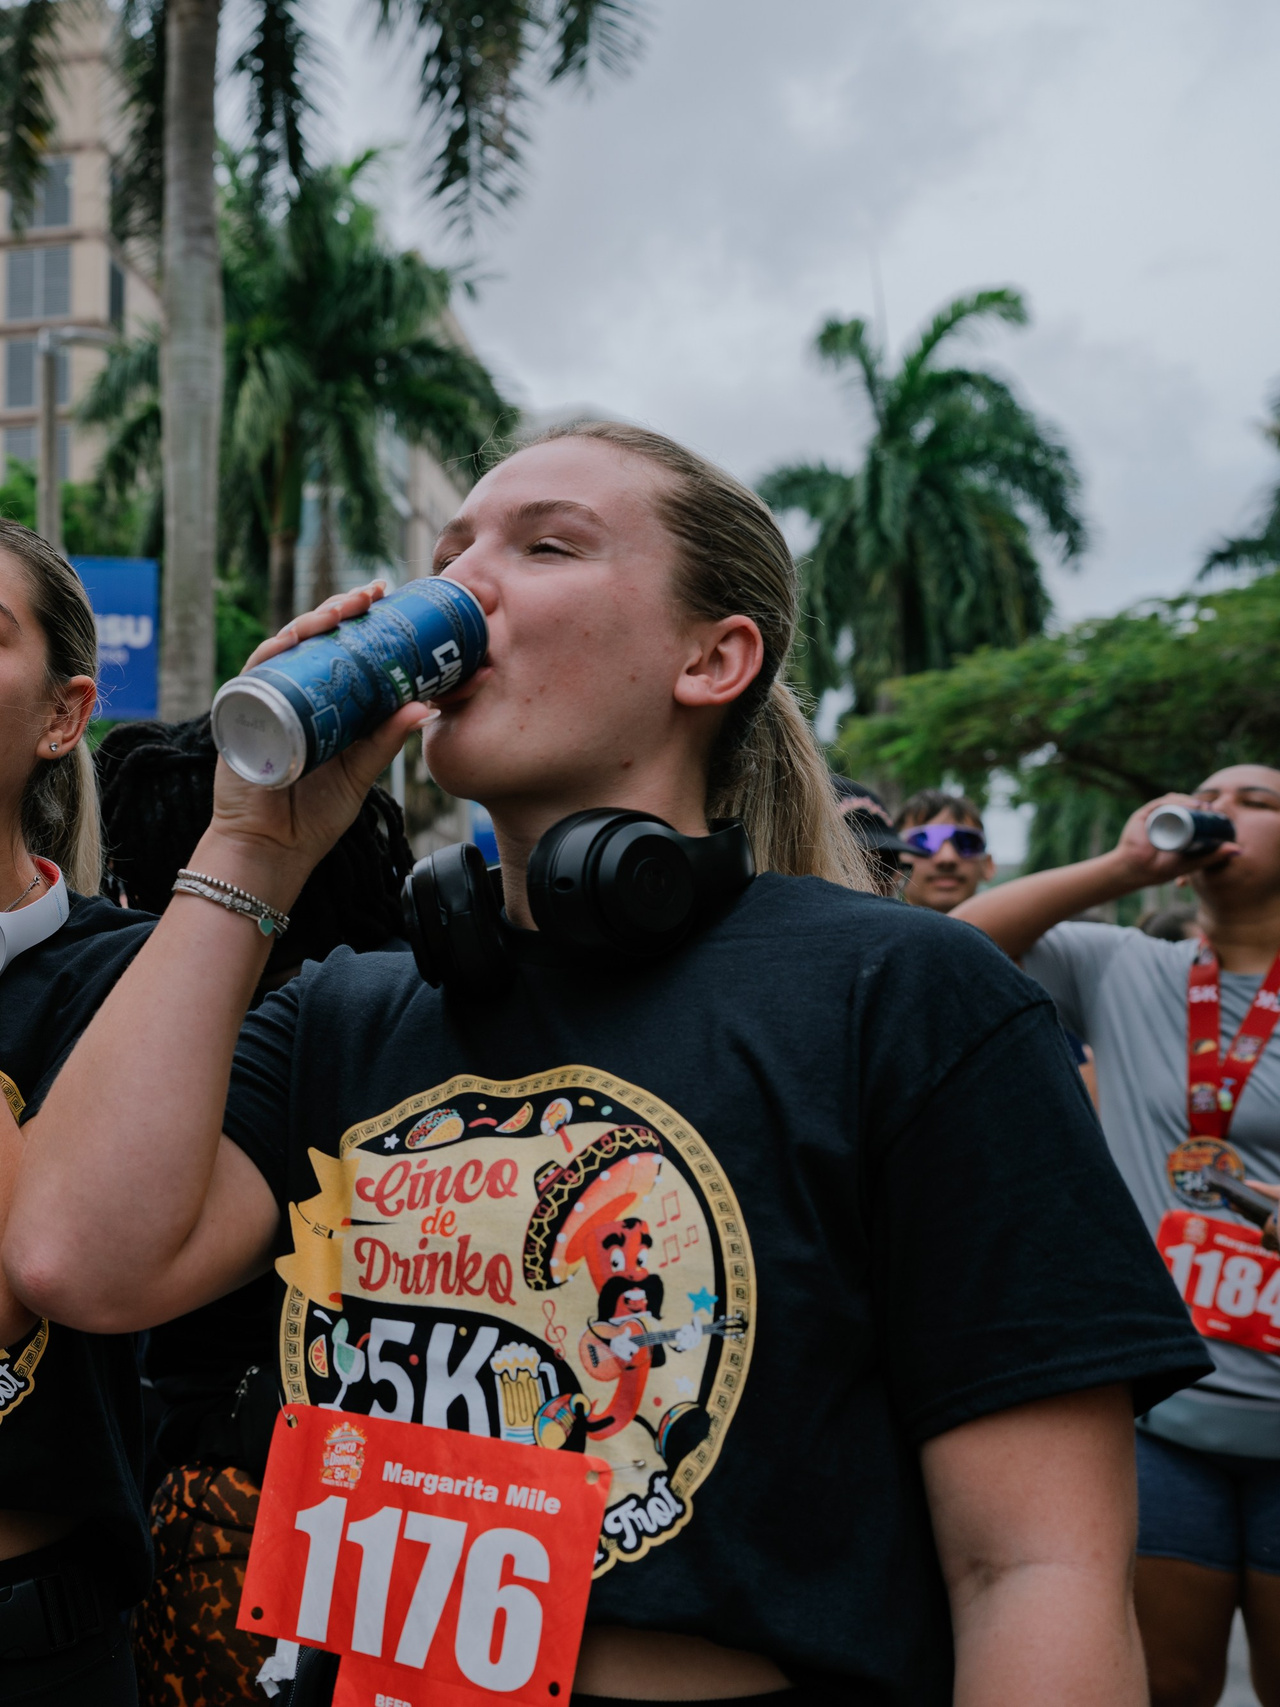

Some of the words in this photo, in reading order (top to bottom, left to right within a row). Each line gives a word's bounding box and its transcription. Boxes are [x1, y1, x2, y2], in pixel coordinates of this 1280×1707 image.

[356, 1158, 518, 1217] Cinco
[420, 1206, 458, 1238] de
[354, 1234, 517, 1306] Drinko
[368, 1317, 500, 1438] 5K
[382, 1461, 499, 1503] Margarita
[505, 1484, 562, 1515] Mile
[604, 1476, 683, 1549] Trot
[294, 1495, 551, 1693] 1176
